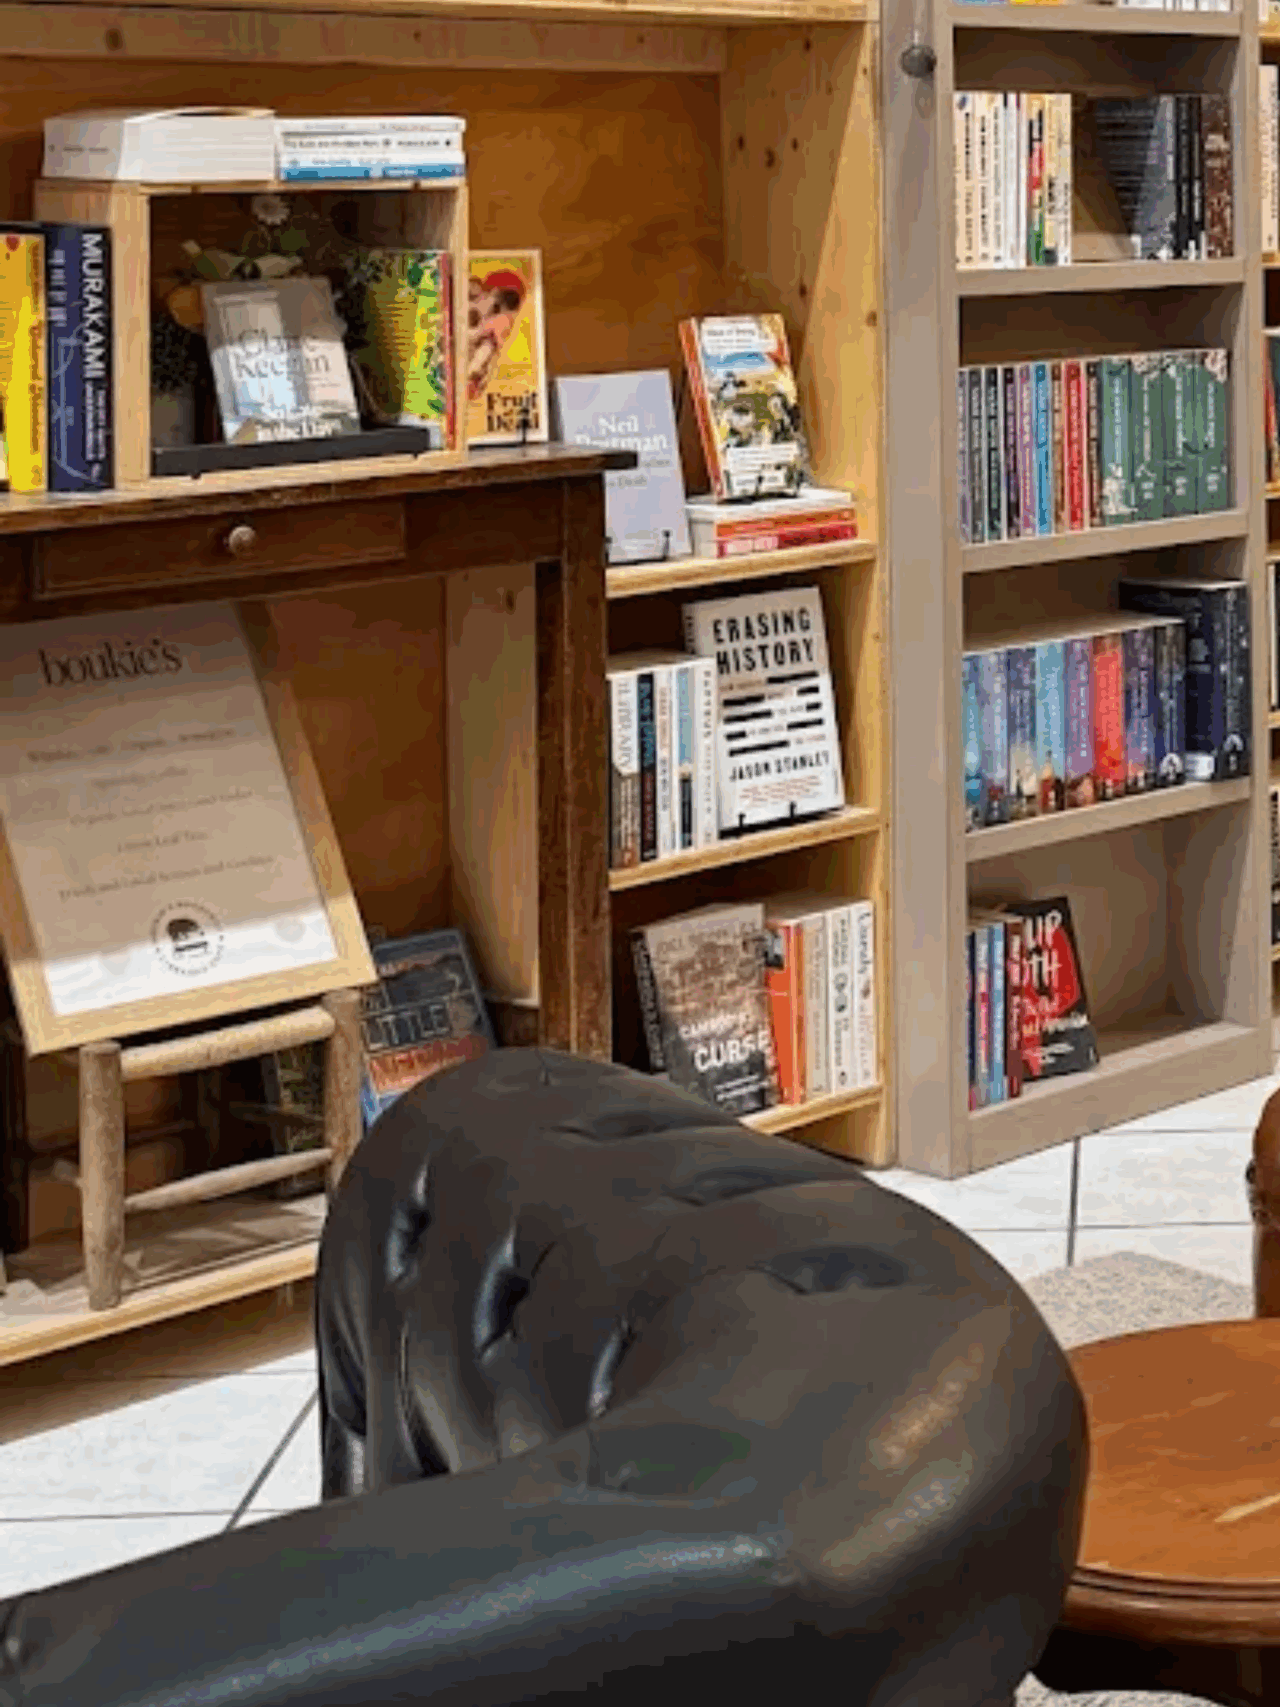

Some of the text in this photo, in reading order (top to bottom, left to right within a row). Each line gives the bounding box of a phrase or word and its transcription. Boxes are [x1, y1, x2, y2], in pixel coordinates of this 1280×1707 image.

[82, 232, 106, 379] MURAKAMI
[486, 389, 539, 412] Fruit
[599, 413, 639, 435] Neil
[713, 607, 812, 644] ERASING
[38, 638, 184, 687] boukie's
[716, 638, 815, 676] HISTORY
[729, 749, 830, 783] JASON STANLEY
[694, 1028, 770, 1073] CURSE
